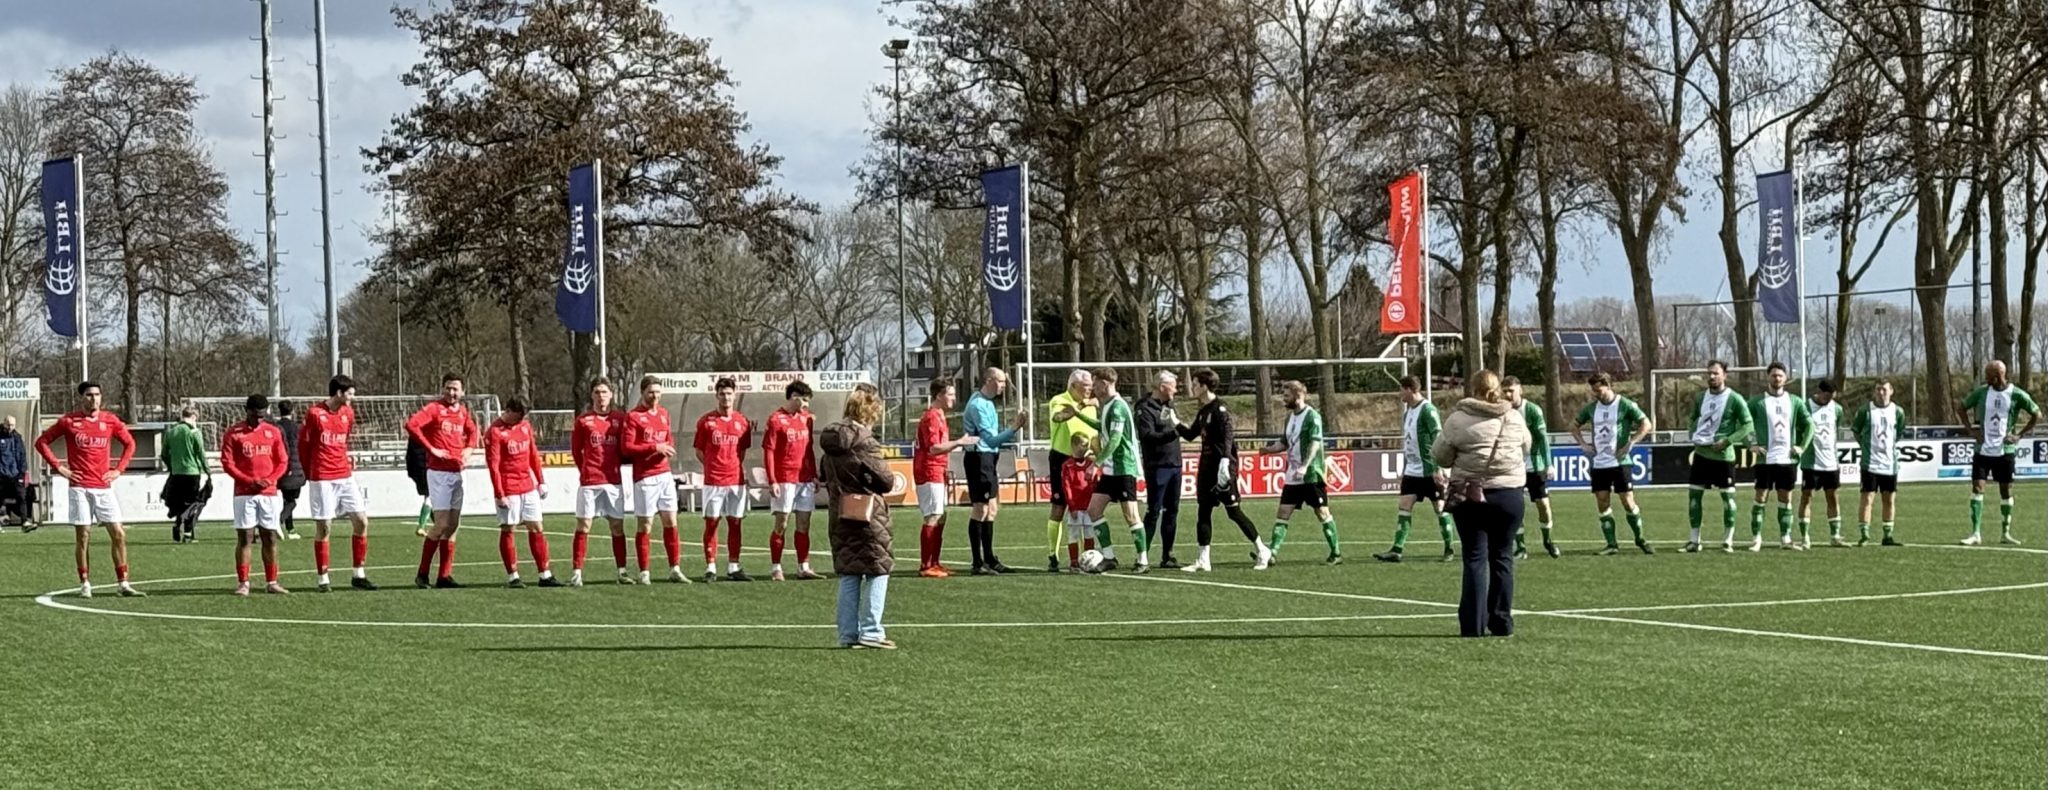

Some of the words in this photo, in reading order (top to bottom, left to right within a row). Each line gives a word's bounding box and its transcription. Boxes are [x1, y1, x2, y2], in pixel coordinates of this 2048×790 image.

[820, 372, 861, 381] EVENT
[0, 380, 29, 389] KOOP
[1948, 443, 1975, 458] 365
